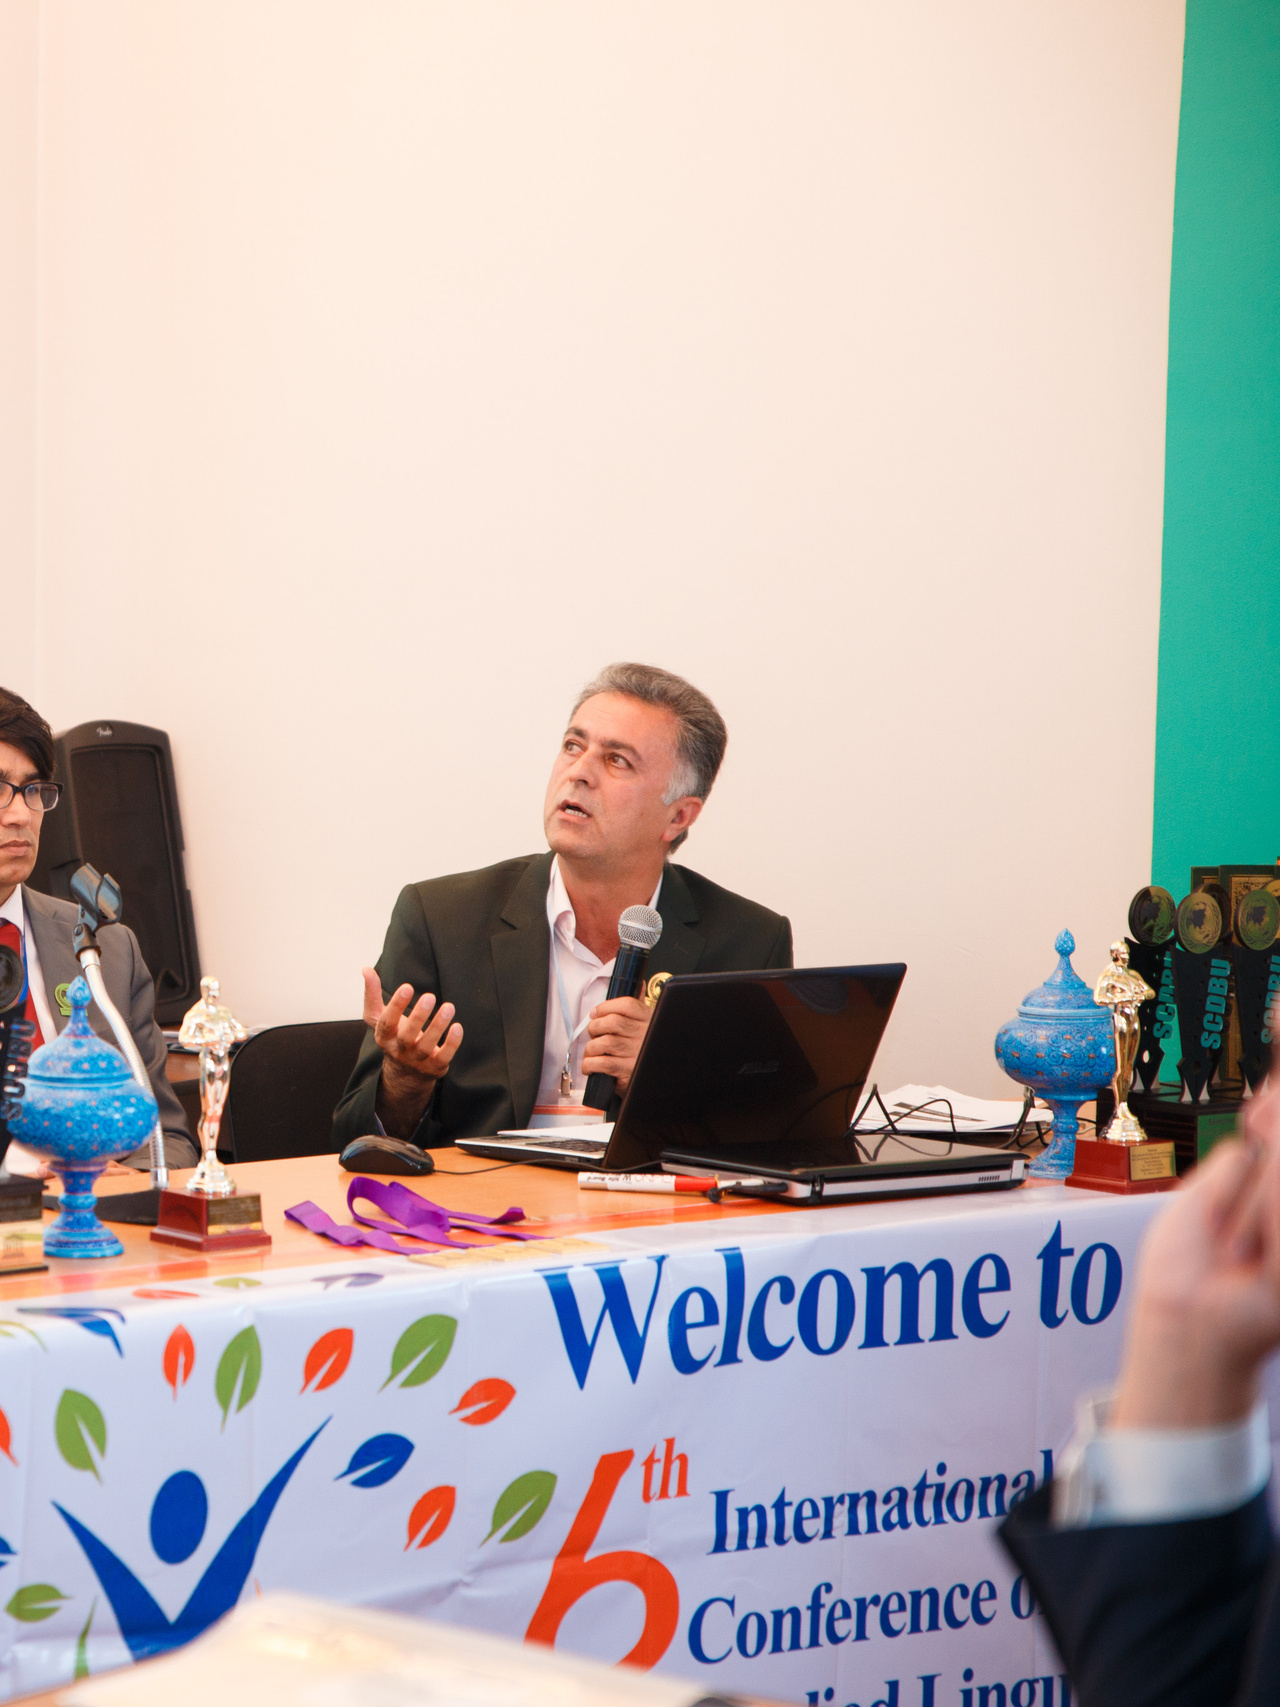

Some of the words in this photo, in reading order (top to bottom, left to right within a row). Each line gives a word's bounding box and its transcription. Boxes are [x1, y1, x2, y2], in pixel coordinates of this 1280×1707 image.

[1200, 958, 1231, 1050] SCDBU
[534, 1247, 1011, 1391] Welcome
[1036, 1220, 1123, 1329] to
[688, 1579, 998, 1664] Conference
[1010, 1573, 1046, 1620] o
